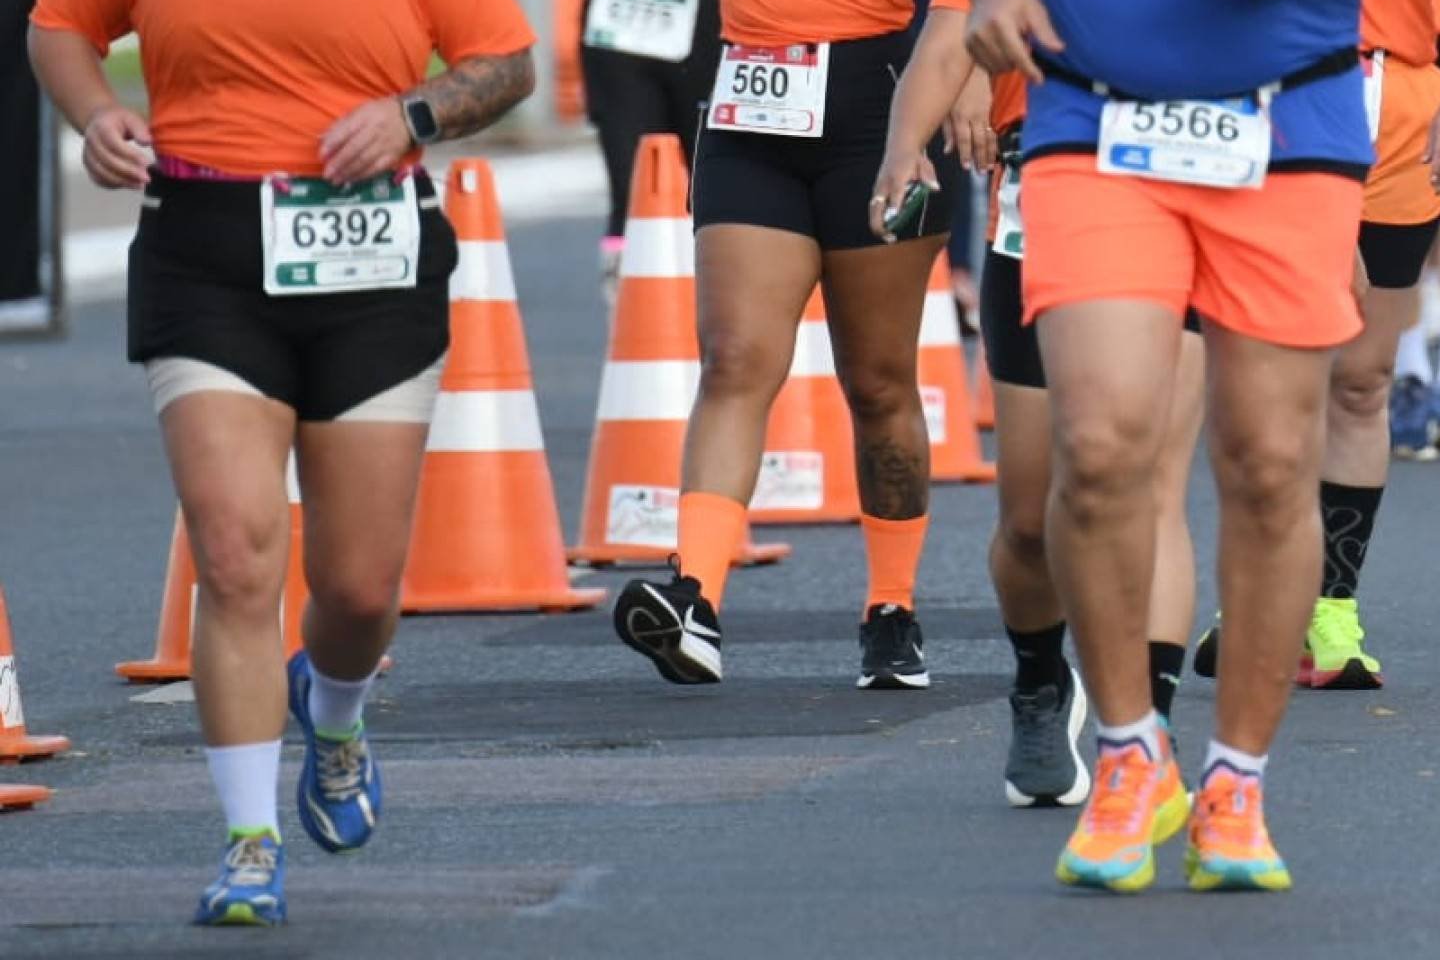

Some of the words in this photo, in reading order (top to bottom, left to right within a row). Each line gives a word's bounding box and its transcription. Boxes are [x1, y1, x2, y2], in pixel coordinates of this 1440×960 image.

[732, 64, 789, 98] 560
[1132, 102, 1239, 141] 5566
[292, 207, 393, 248] 6392
